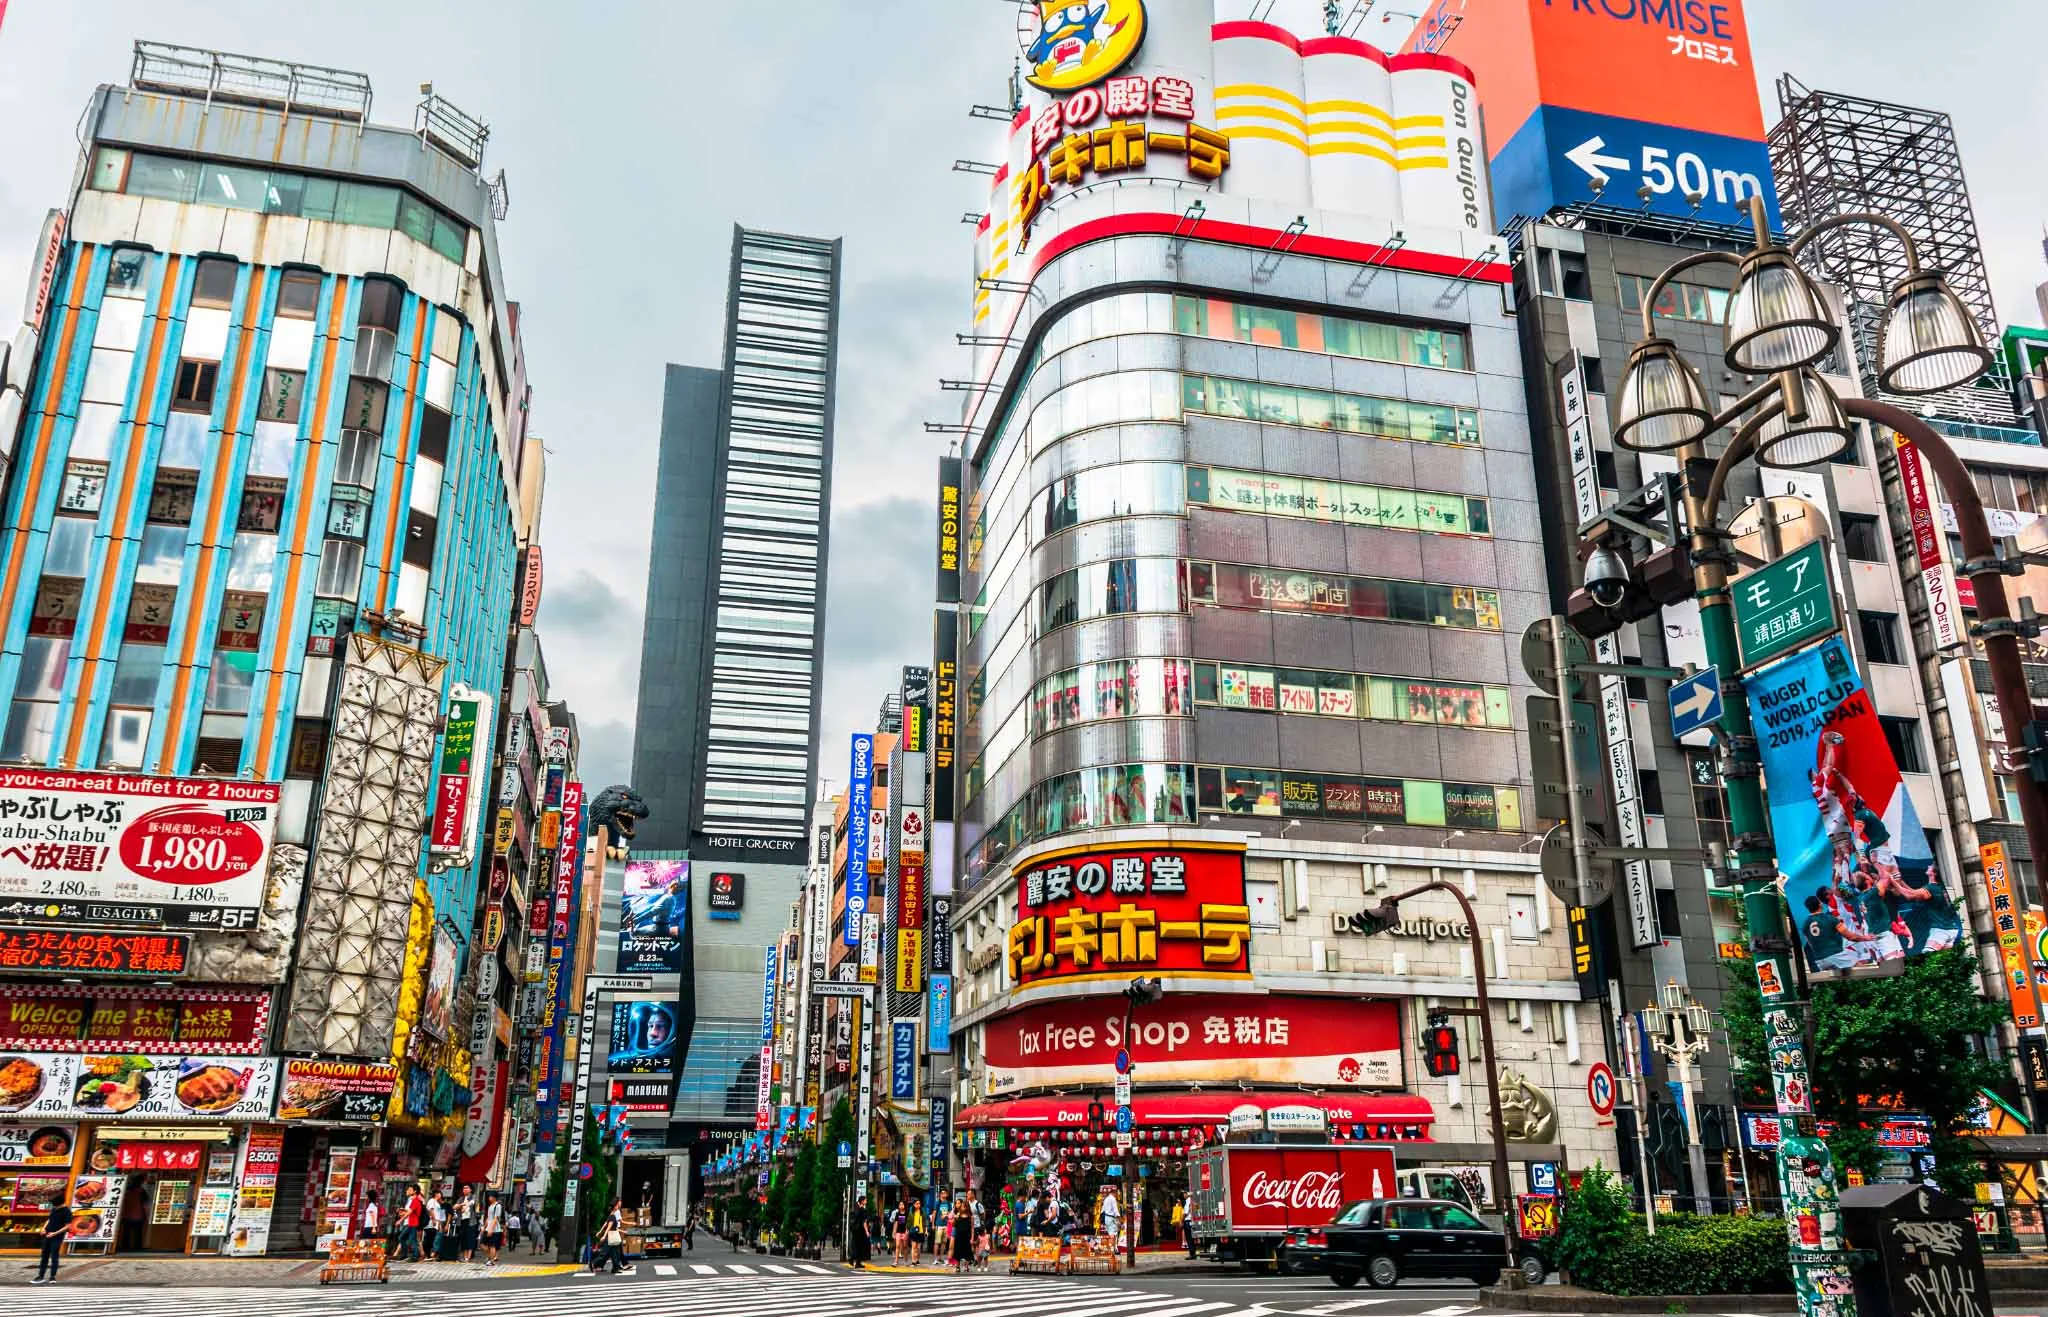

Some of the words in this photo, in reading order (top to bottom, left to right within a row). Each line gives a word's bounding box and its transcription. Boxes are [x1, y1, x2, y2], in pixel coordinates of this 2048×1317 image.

[1667, 35, 1738, 66] プロミス
[1450, 80, 1467, 129] Don
[1455, 137, 1480, 229] Quijote
[1642, 145, 1763, 205] 50m
[942, 486, 958, 570] 驚安の殿堂
[1747, 557, 1810, 608] モア
[1755, 600, 1816, 645] 靖国通り
[1249, 686, 1274, 709] 新宿
[1281, 688, 1315, 711] アイドル
[1320, 691, 1353, 714] ステージ
[1760, 677, 1808, 710] RUGBY
[1811, 700, 1866, 733] JAPAN
[855, 737, 872, 779] Booth
[1612, 748, 1626, 800] ESOLA
[117, 778, 171, 796] buffet
[177, 782, 202, 797] for
[208, 783, 220, 797] 2
[224, 783, 274, 800] hours
[1283, 781, 1319, 801] 販売
[1325, 788, 1361, 802] ブランド
[1367, 790, 1401, 805] 時計
[228, 807, 264, 822] 120分
[443, 784, 462, 844] ひょうたん
[135, 834, 227, 872] 1,980
[225, 859, 249, 873] yen
[709, 837, 744, 848] HOTEL
[746, 839, 796, 850] GRACERY
[852, 783, 868, 892] きれいなネットカフェ
[1026, 855, 1186, 907] 驚安の殿堂
[221, 908, 256, 928] 5F
[1631, 865, 1648, 942] ミステリアス
[1994, 893, 2016, 932] 麻雀
[1809, 921, 1820, 938] 6
[20, 1023, 57, 1036] OPEN
[1203, 1015, 1290, 1047] 免税店
[2017, 1015, 2036, 1026] 3F
[576, 1003, 596, 1093] GODZILLA
[1018, 1028, 1041, 1057] Tax
[1045, 1023, 1096, 1052] Free
[48, 1057, 60, 1077] そば
[290, 1061, 360, 1076] OKONOMI
[364, 1064, 397, 1078] YAKI
[611, 1058, 671, 1067] アド・アストラ
[896, 1026, 912, 1094] カラオケ
[1368, 1060, 1388, 1068] Japan
[57, 1057, 75, 1097] かき揚げ
[256, 1059, 273, 1100] かつ丼
[626, 1085, 669, 1096] MARUHAN
[35, 1100, 68, 1112] 450円
[136, 1101, 169, 1113] 500円
[236, 1101, 268, 1113] 520円
[1057, 1110, 1083, 1122] Don
[1118, 1115, 1126, 1128] P
[571, 1102, 586, 1146] ROAD
[710, 1131, 733, 1139] TOHO
[932, 1100, 945, 1157] カラオケ
[1753, 1118, 1781, 1144] 薬
[932, 1160, 944, 1168] B1
[1534, 1167, 1545, 1186] P
[1242, 1170, 1346, 1209] Coca-Cola
